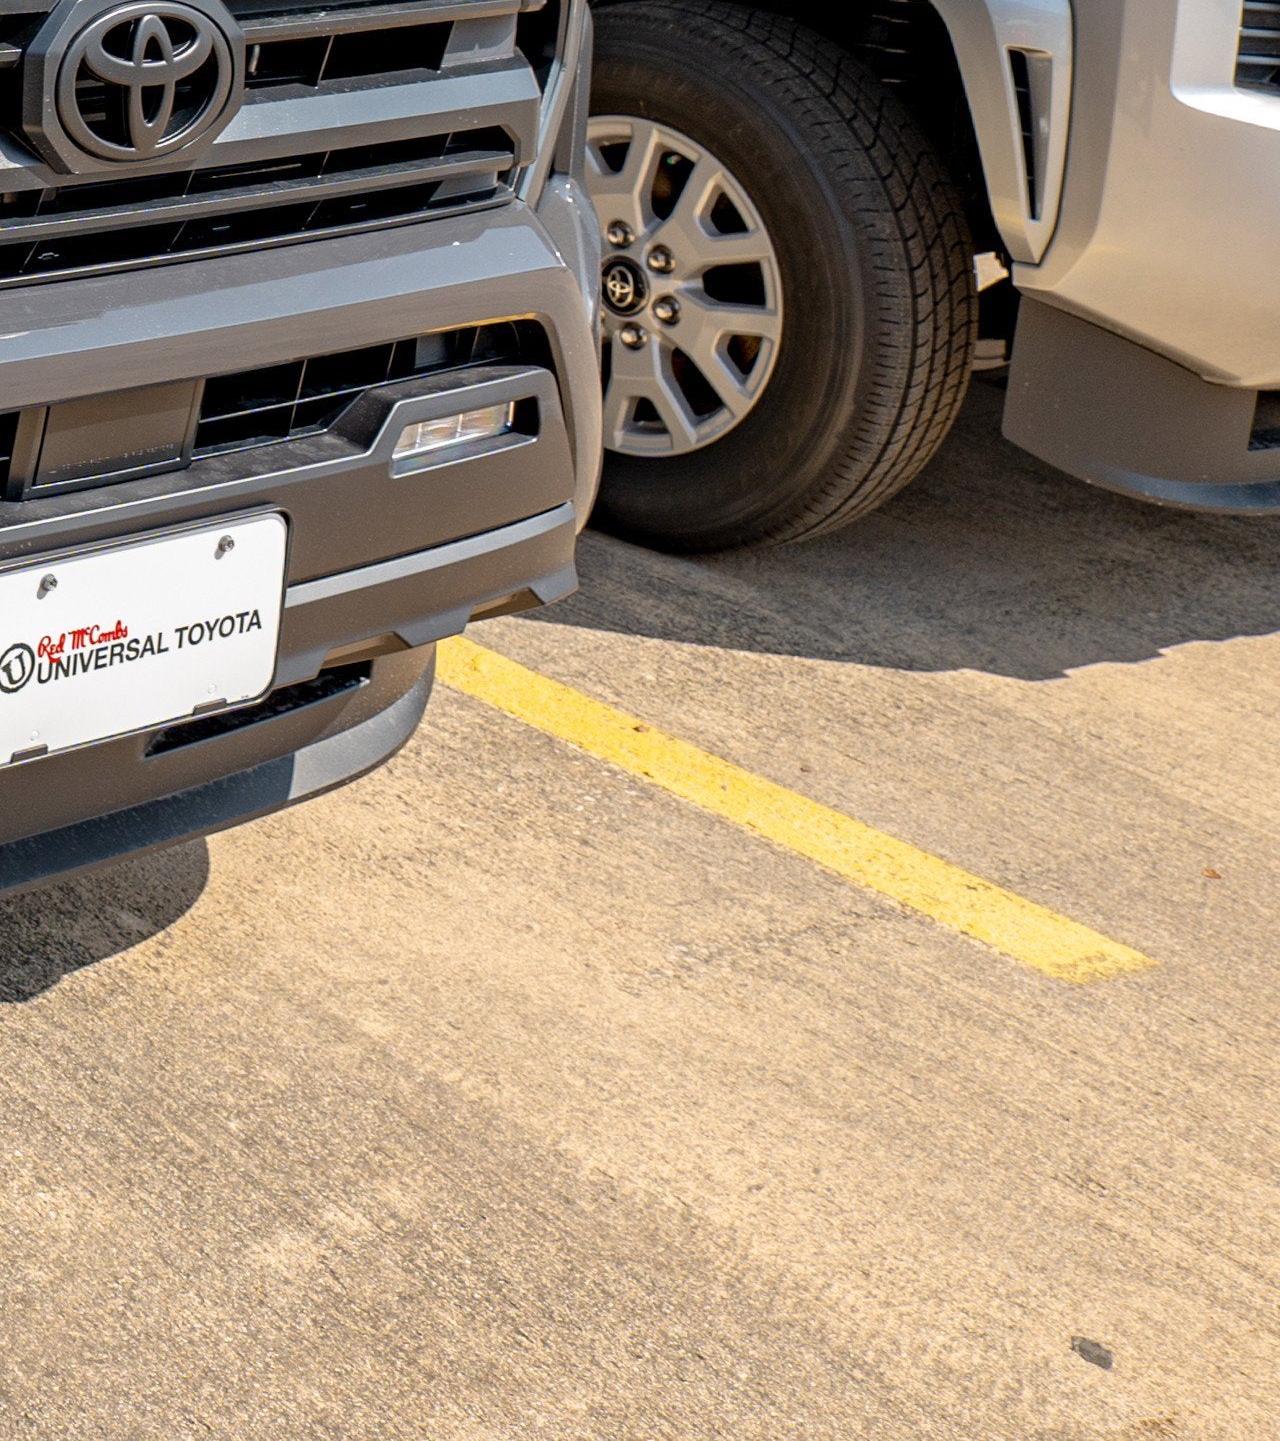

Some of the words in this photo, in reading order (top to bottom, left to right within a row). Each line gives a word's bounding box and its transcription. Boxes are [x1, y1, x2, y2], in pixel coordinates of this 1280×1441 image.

[37, 634, 66, 663] Red
[68, 620, 129, 650] McCombs
[37, 633, 169, 684] UNIVERSAL
[174, 609, 262, 649] TOYOTA
